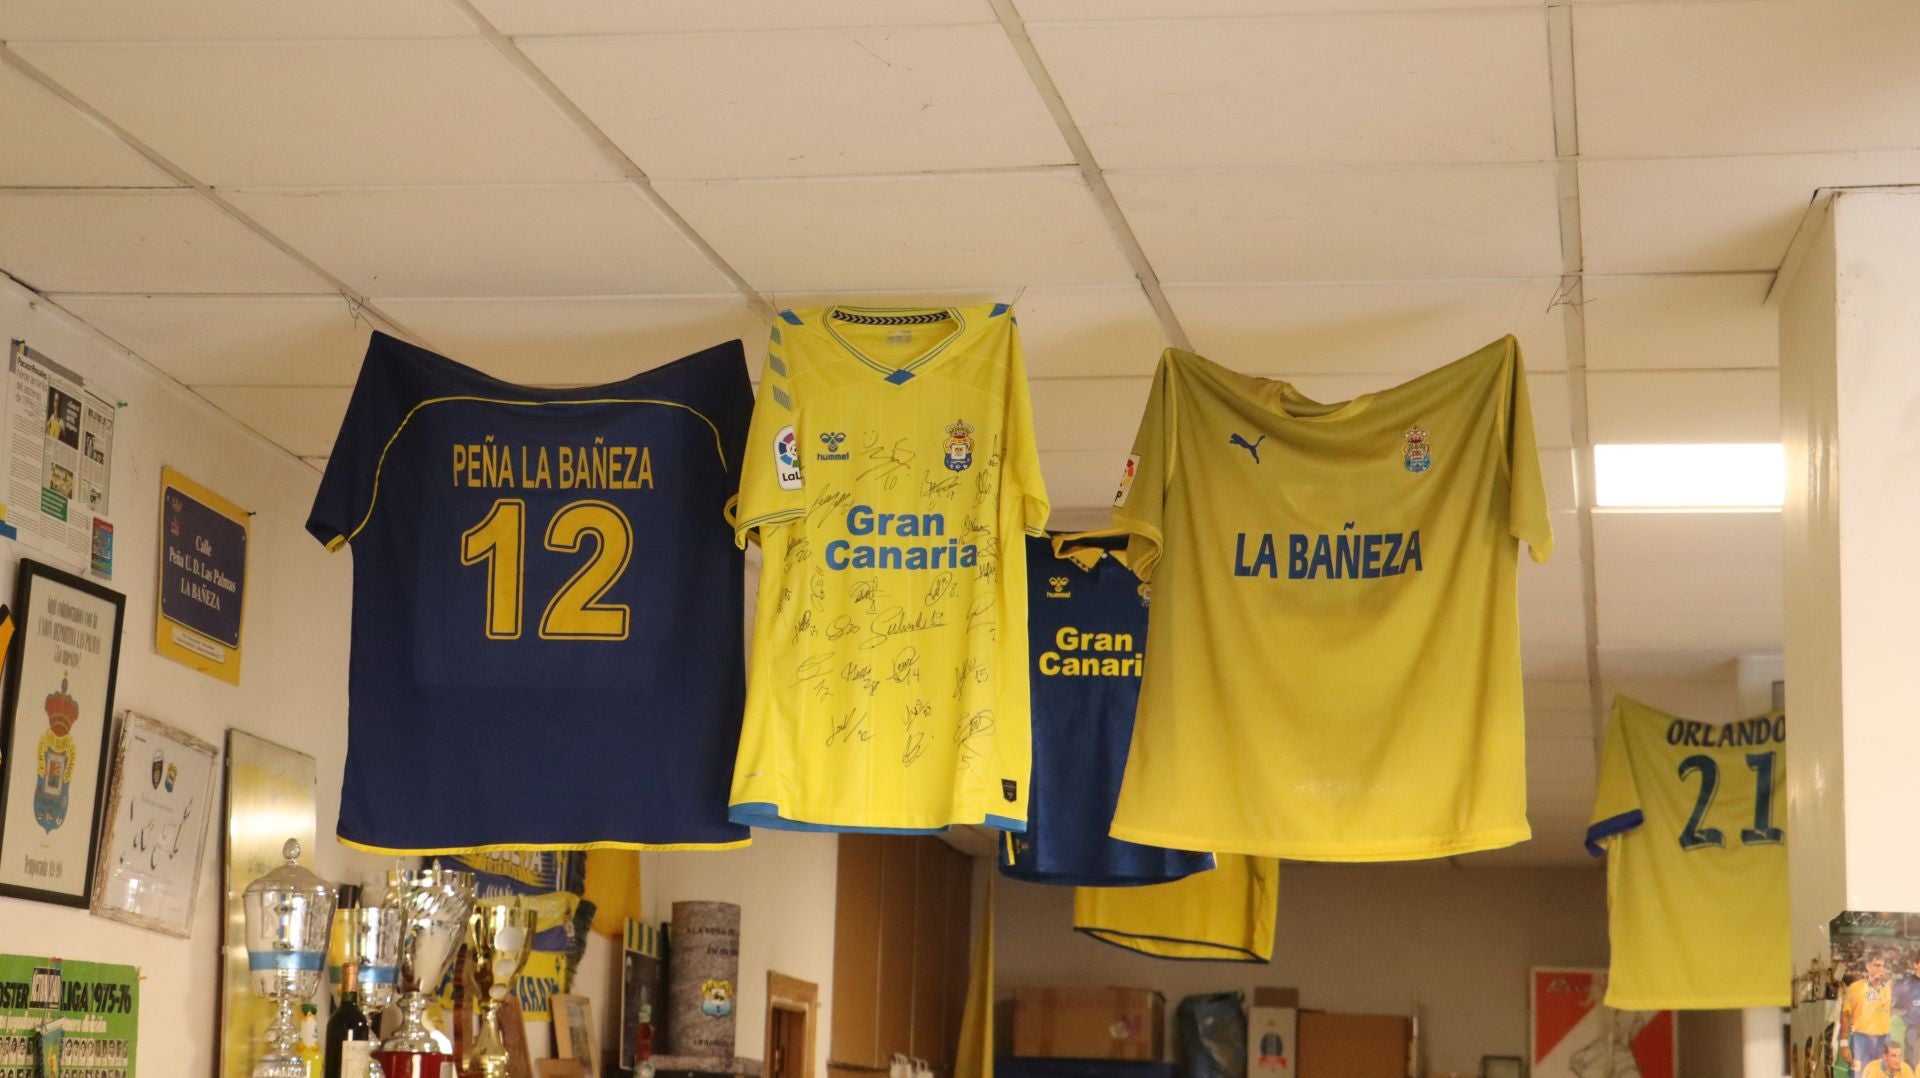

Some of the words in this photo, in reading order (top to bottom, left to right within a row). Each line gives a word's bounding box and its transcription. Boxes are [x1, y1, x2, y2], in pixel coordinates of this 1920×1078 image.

[453, 434, 515, 488] PEÑA
[522, 446, 552, 489] LA
[559, 436, 654, 490] BAÑEZA
[817, 451, 849, 461] hummel
[782, 471, 803, 482] LaL
[846, 504, 945, 537] Gran
[195, 535, 212, 557] Calle
[825, 538, 979, 571] Canaria
[1234, 532, 1278, 579] LA
[1288, 521, 1423, 580] BAÑEZA
[169, 546, 184, 568] Peña
[201, 562, 213, 582] Las
[213, 568, 236, 593] Palmas
[460, 498, 634, 641] 12
[181, 577, 191, 597] LA
[191, 582, 220, 611] BAÑEZA
[1055, 626, 1134, 652] Gran
[1038, 651, 1143, 677] Canari
[1666, 715, 1786, 748] ORLANDO
[1678, 751, 1785, 852] 21
[60, 981, 89, 1012] LIGA
